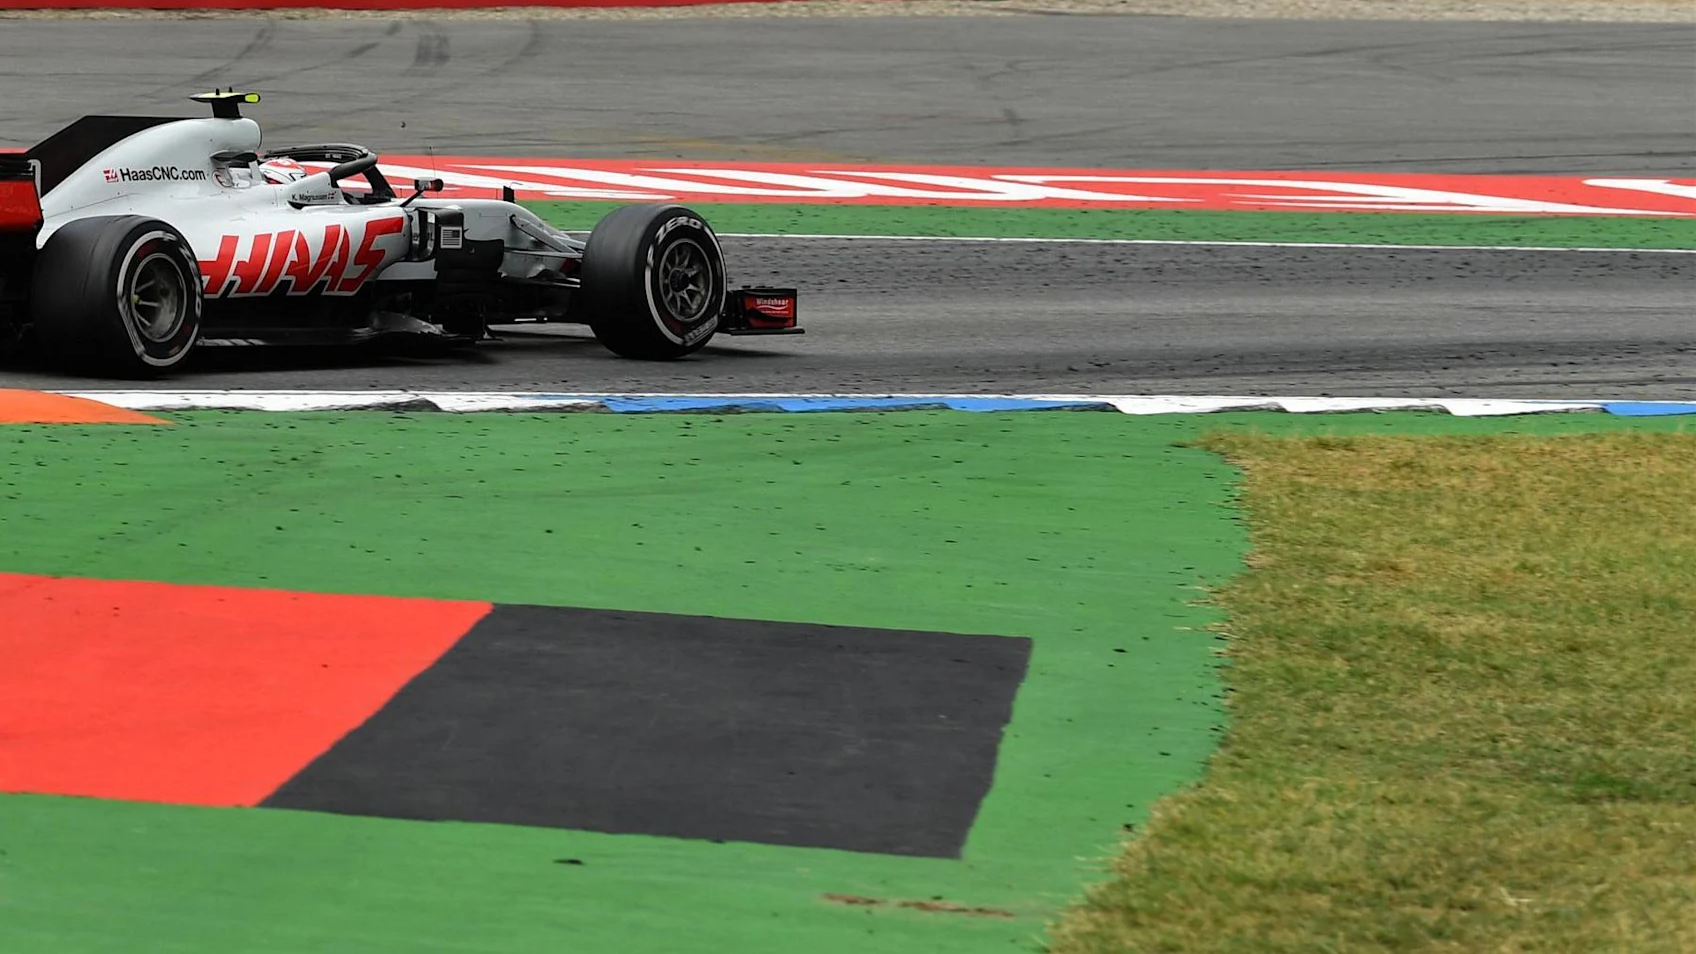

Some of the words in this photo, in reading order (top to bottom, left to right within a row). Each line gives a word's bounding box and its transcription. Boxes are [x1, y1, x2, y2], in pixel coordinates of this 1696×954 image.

[119, 166, 206, 182] HaasCNC.com
[655, 216, 703, 245] ZERO
[197, 216, 405, 298] HAAS
